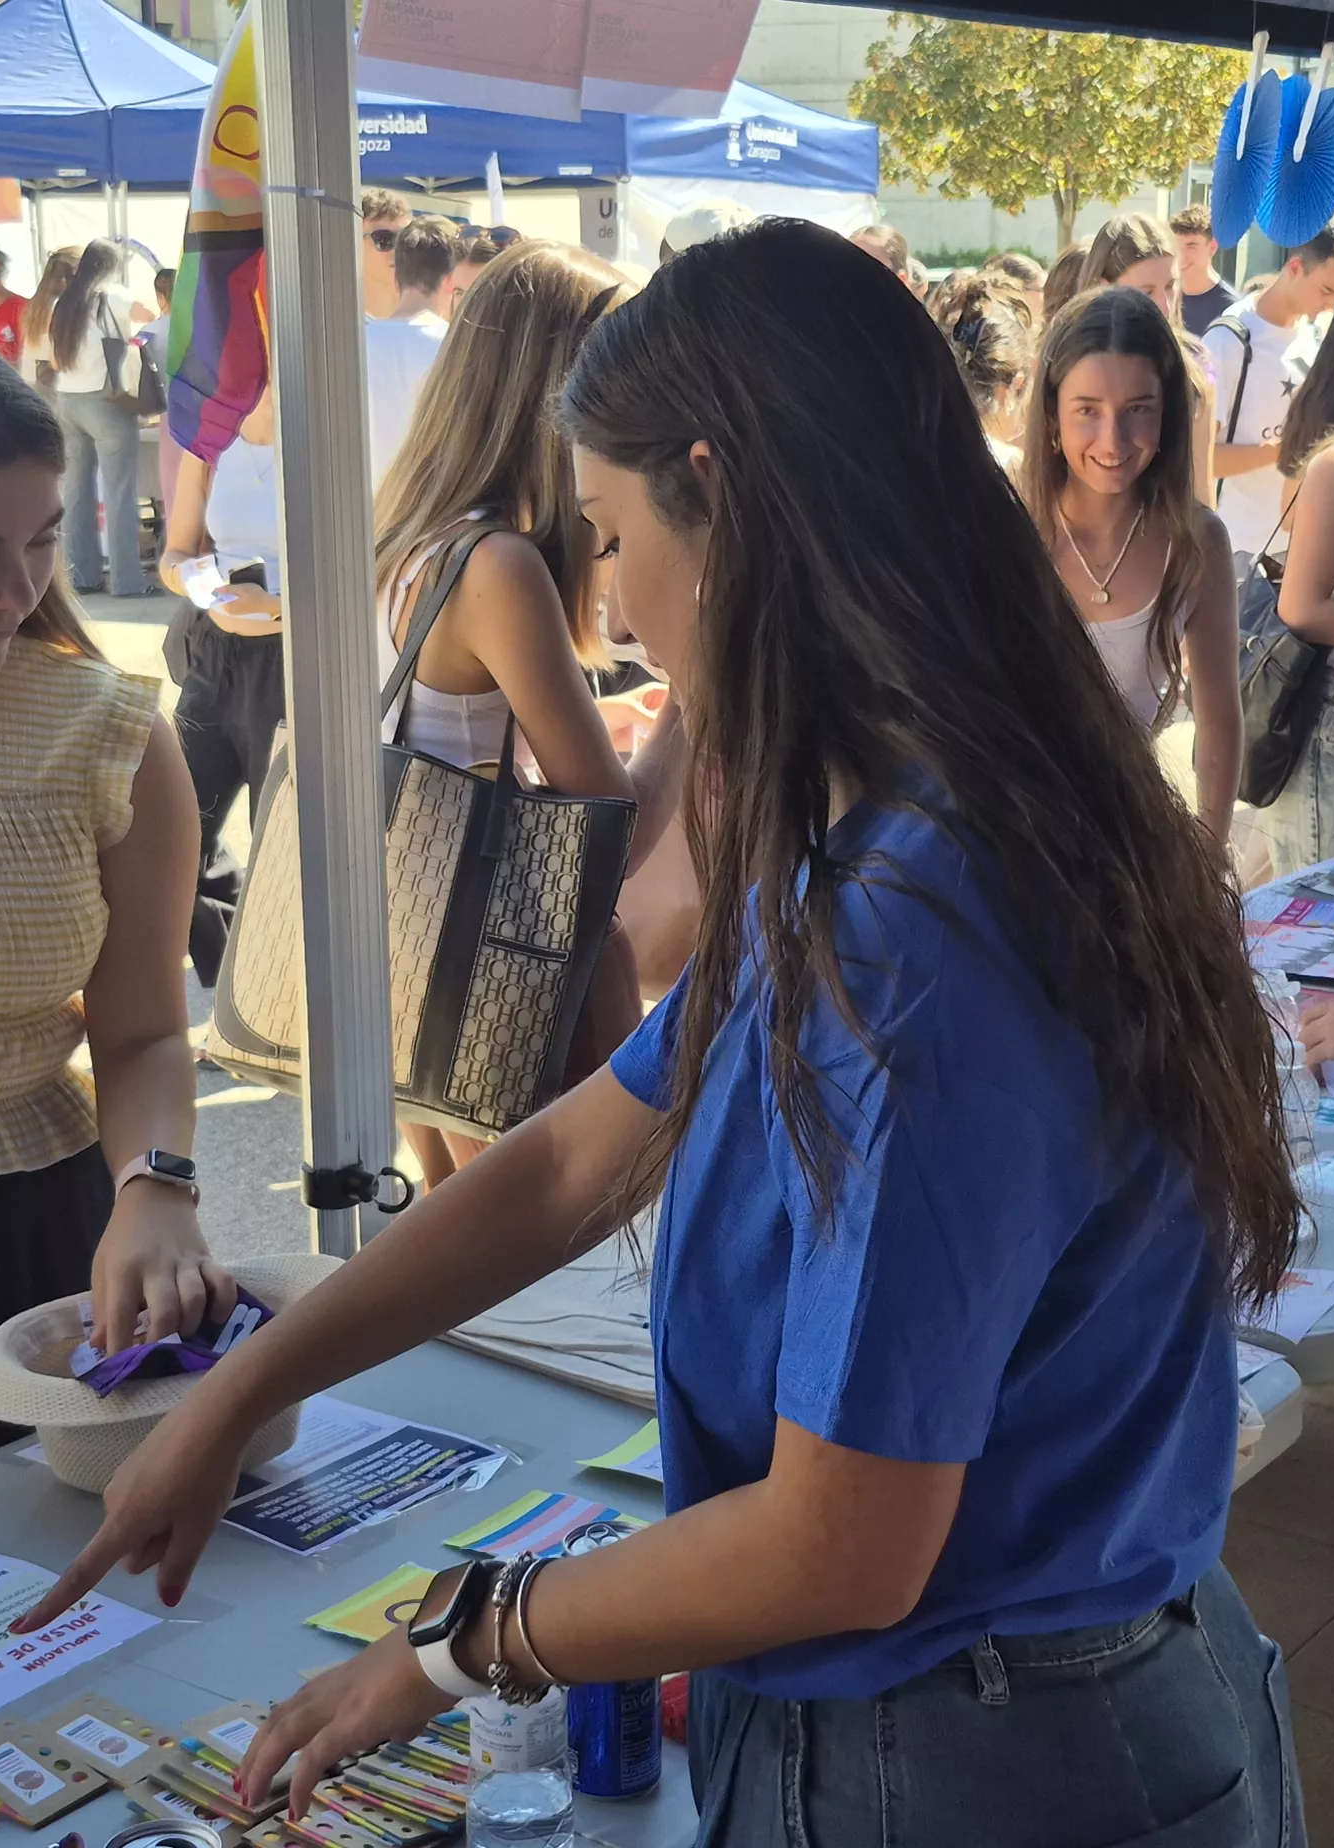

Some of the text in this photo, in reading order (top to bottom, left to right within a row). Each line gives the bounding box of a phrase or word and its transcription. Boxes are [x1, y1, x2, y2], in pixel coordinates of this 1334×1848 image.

[746, 121, 798, 147] Universidad
[35, 1612, 100, 1644] BOLSA
[1, 1642, 40, 1661] DE
[18, 1628, 104, 1672] AMPLIACIÓN
